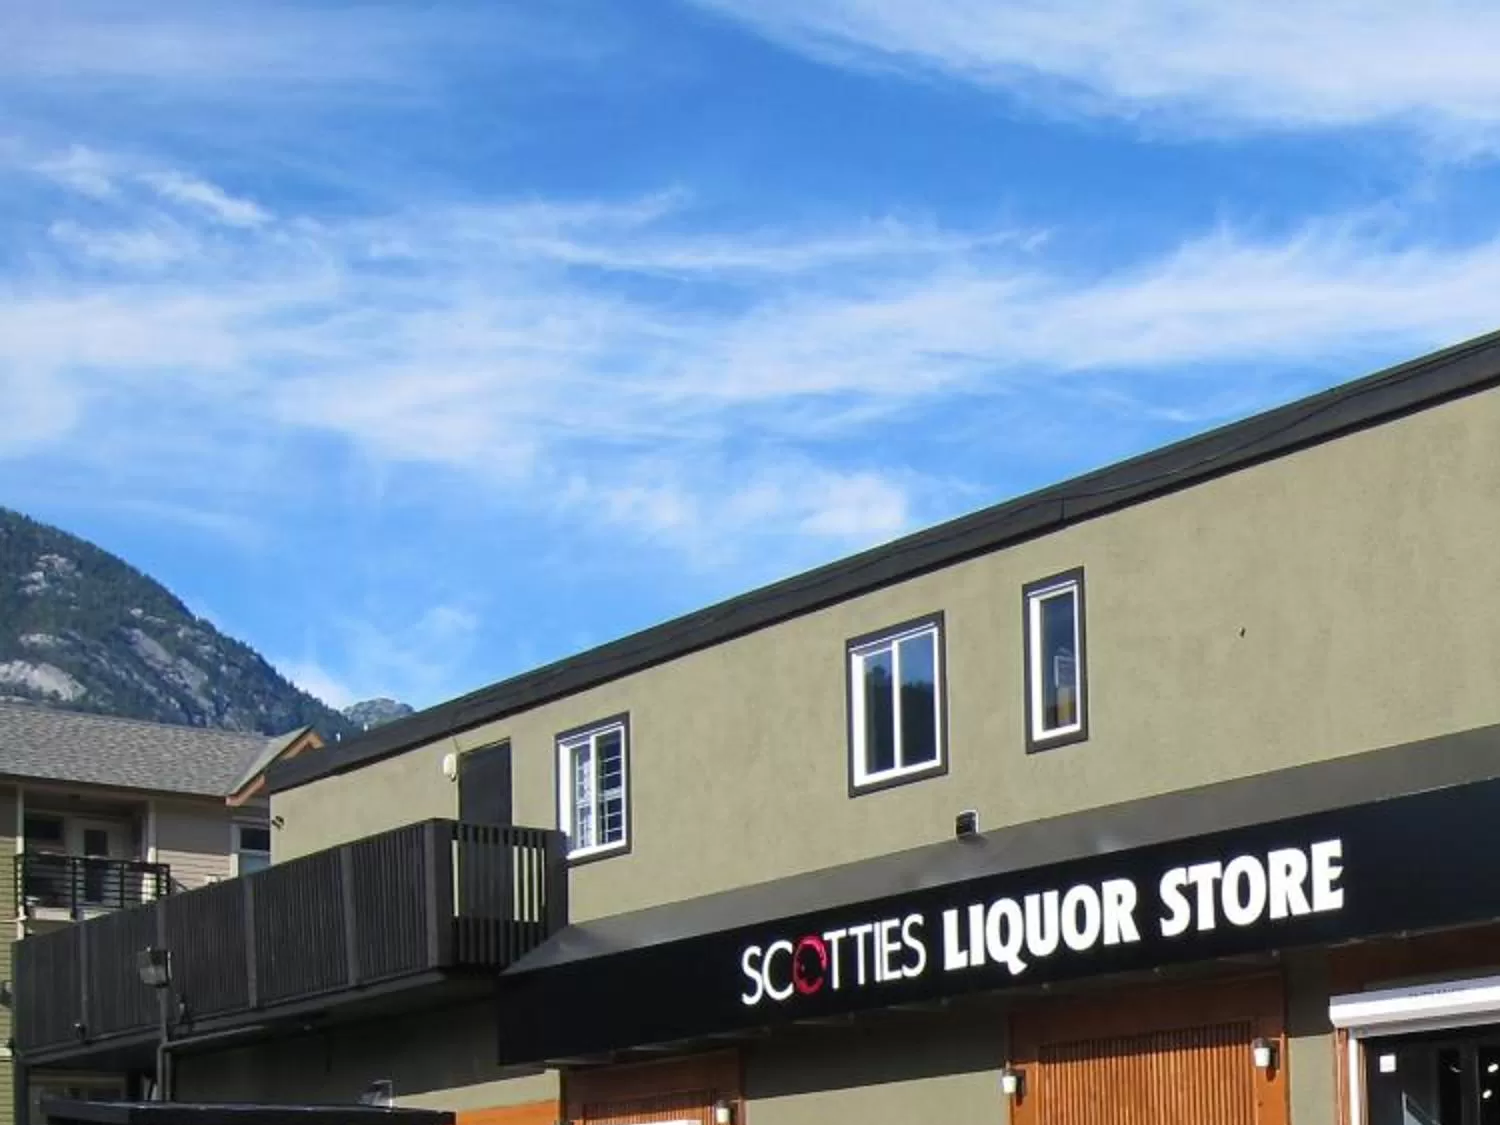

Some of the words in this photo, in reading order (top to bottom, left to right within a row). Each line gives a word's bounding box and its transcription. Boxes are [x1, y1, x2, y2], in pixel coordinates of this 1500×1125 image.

[741, 914, 925, 1005] SCOTTIES
[942, 878, 1140, 976] LIQUOR
[1158, 839, 1345, 938] STORE
